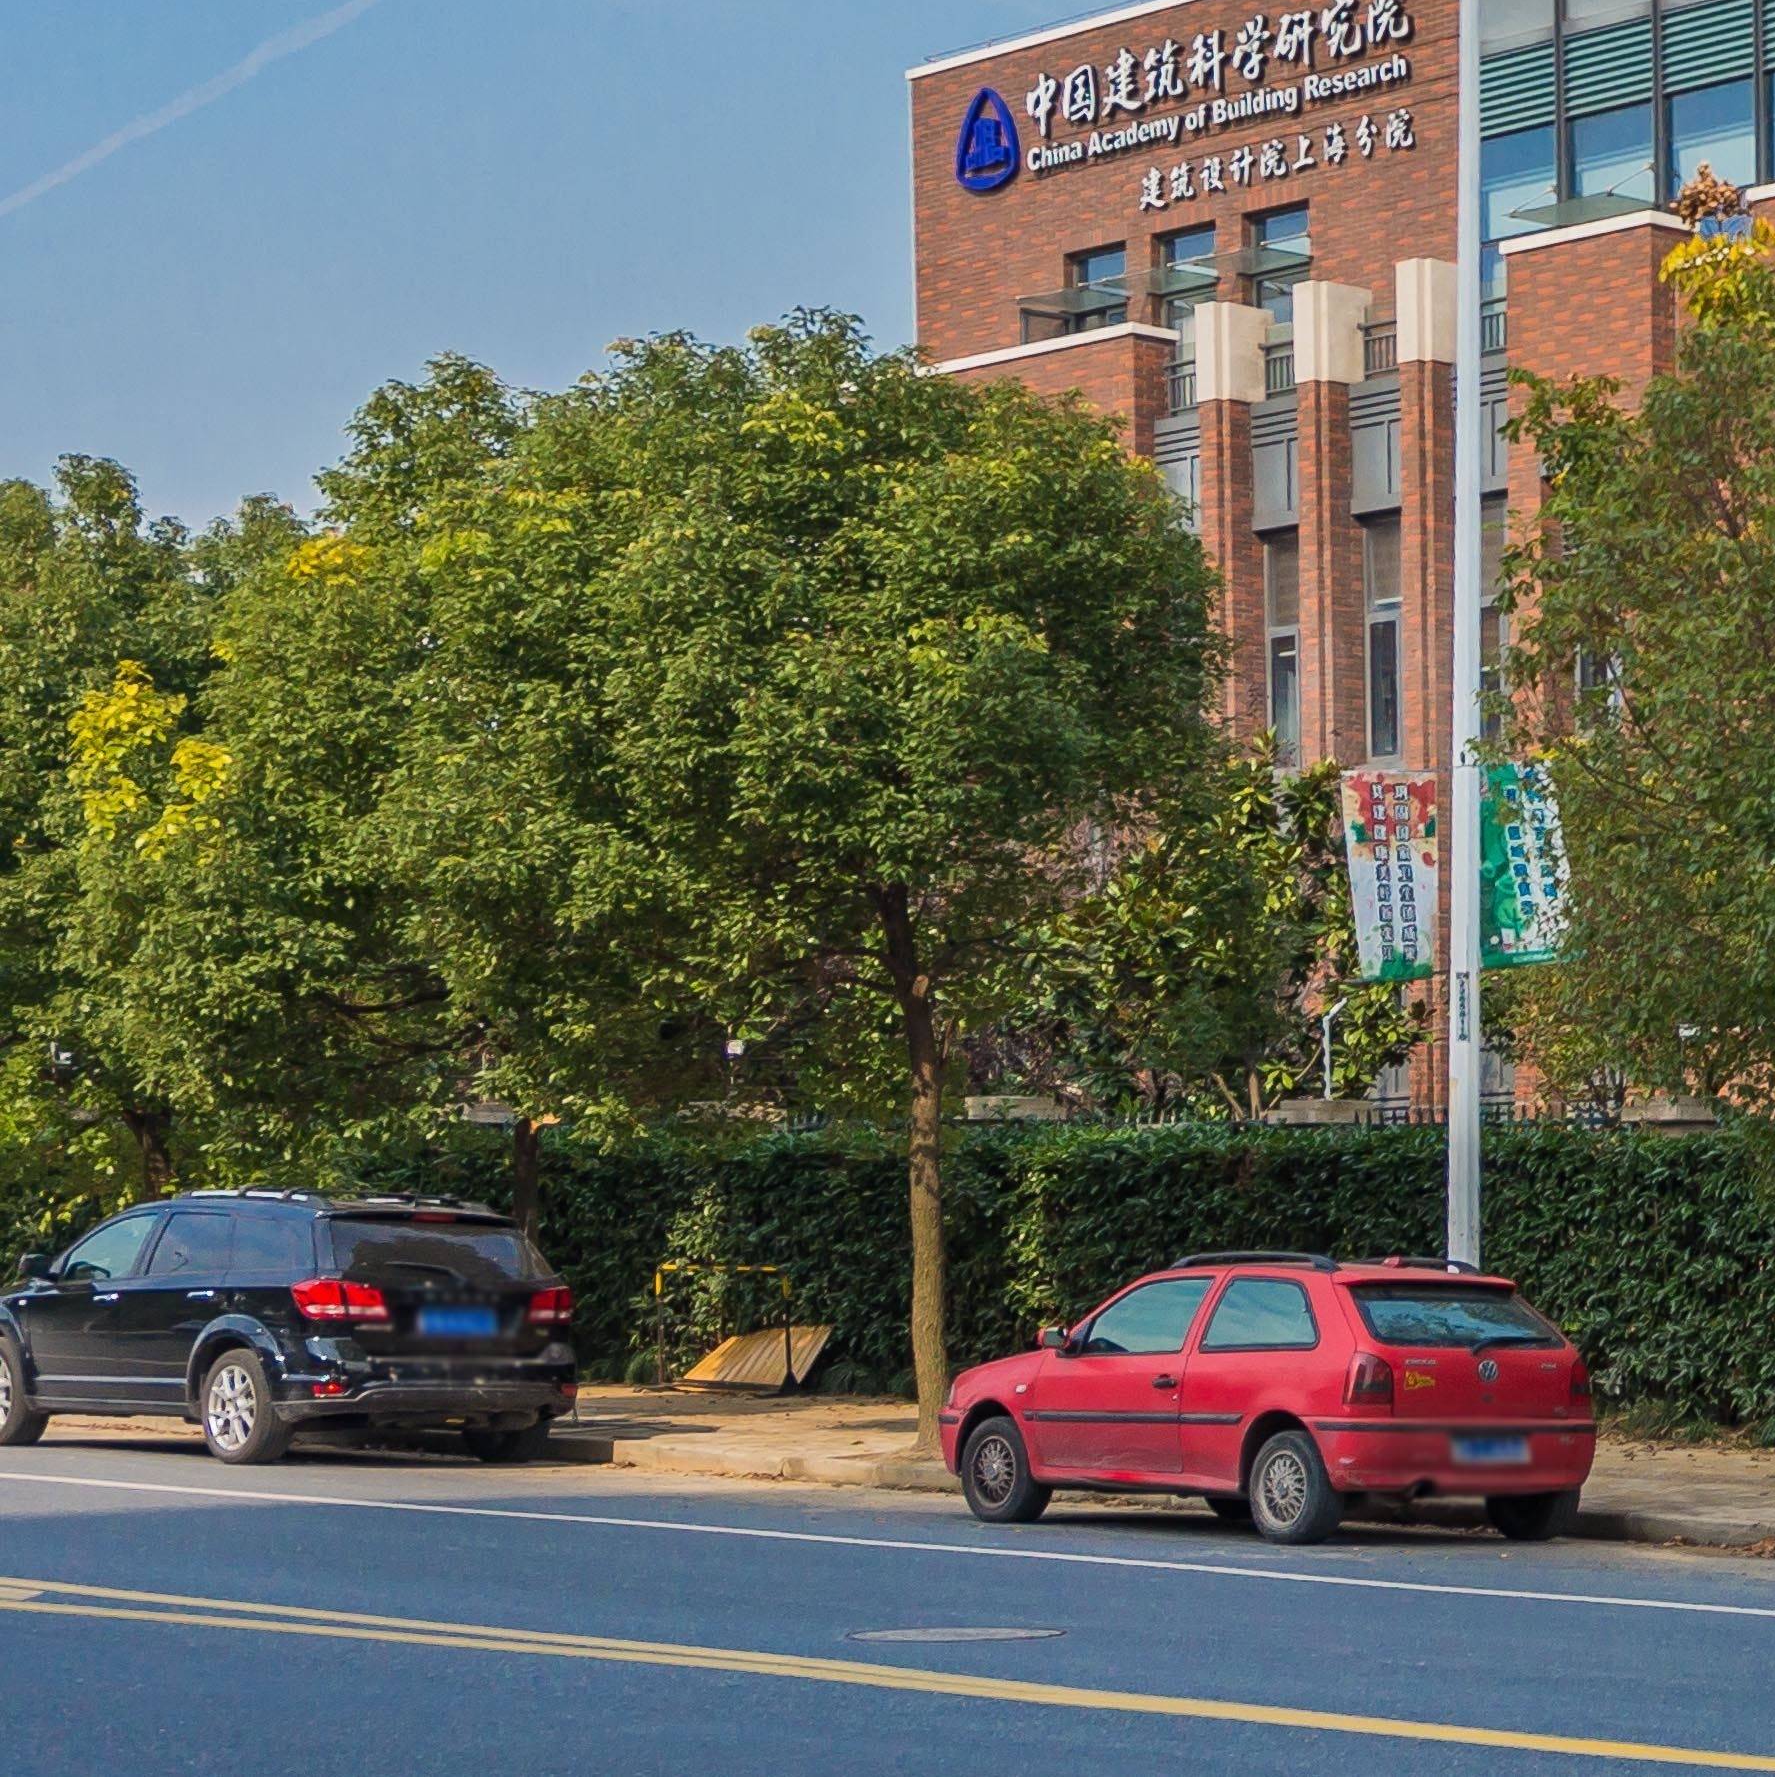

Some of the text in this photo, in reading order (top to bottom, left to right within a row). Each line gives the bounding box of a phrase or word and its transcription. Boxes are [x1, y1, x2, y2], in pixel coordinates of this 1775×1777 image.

[1026, 52, 1407, 172] China Academy of Building Research
[1138, 107, 1414, 212] 建筑设计院上海分院
